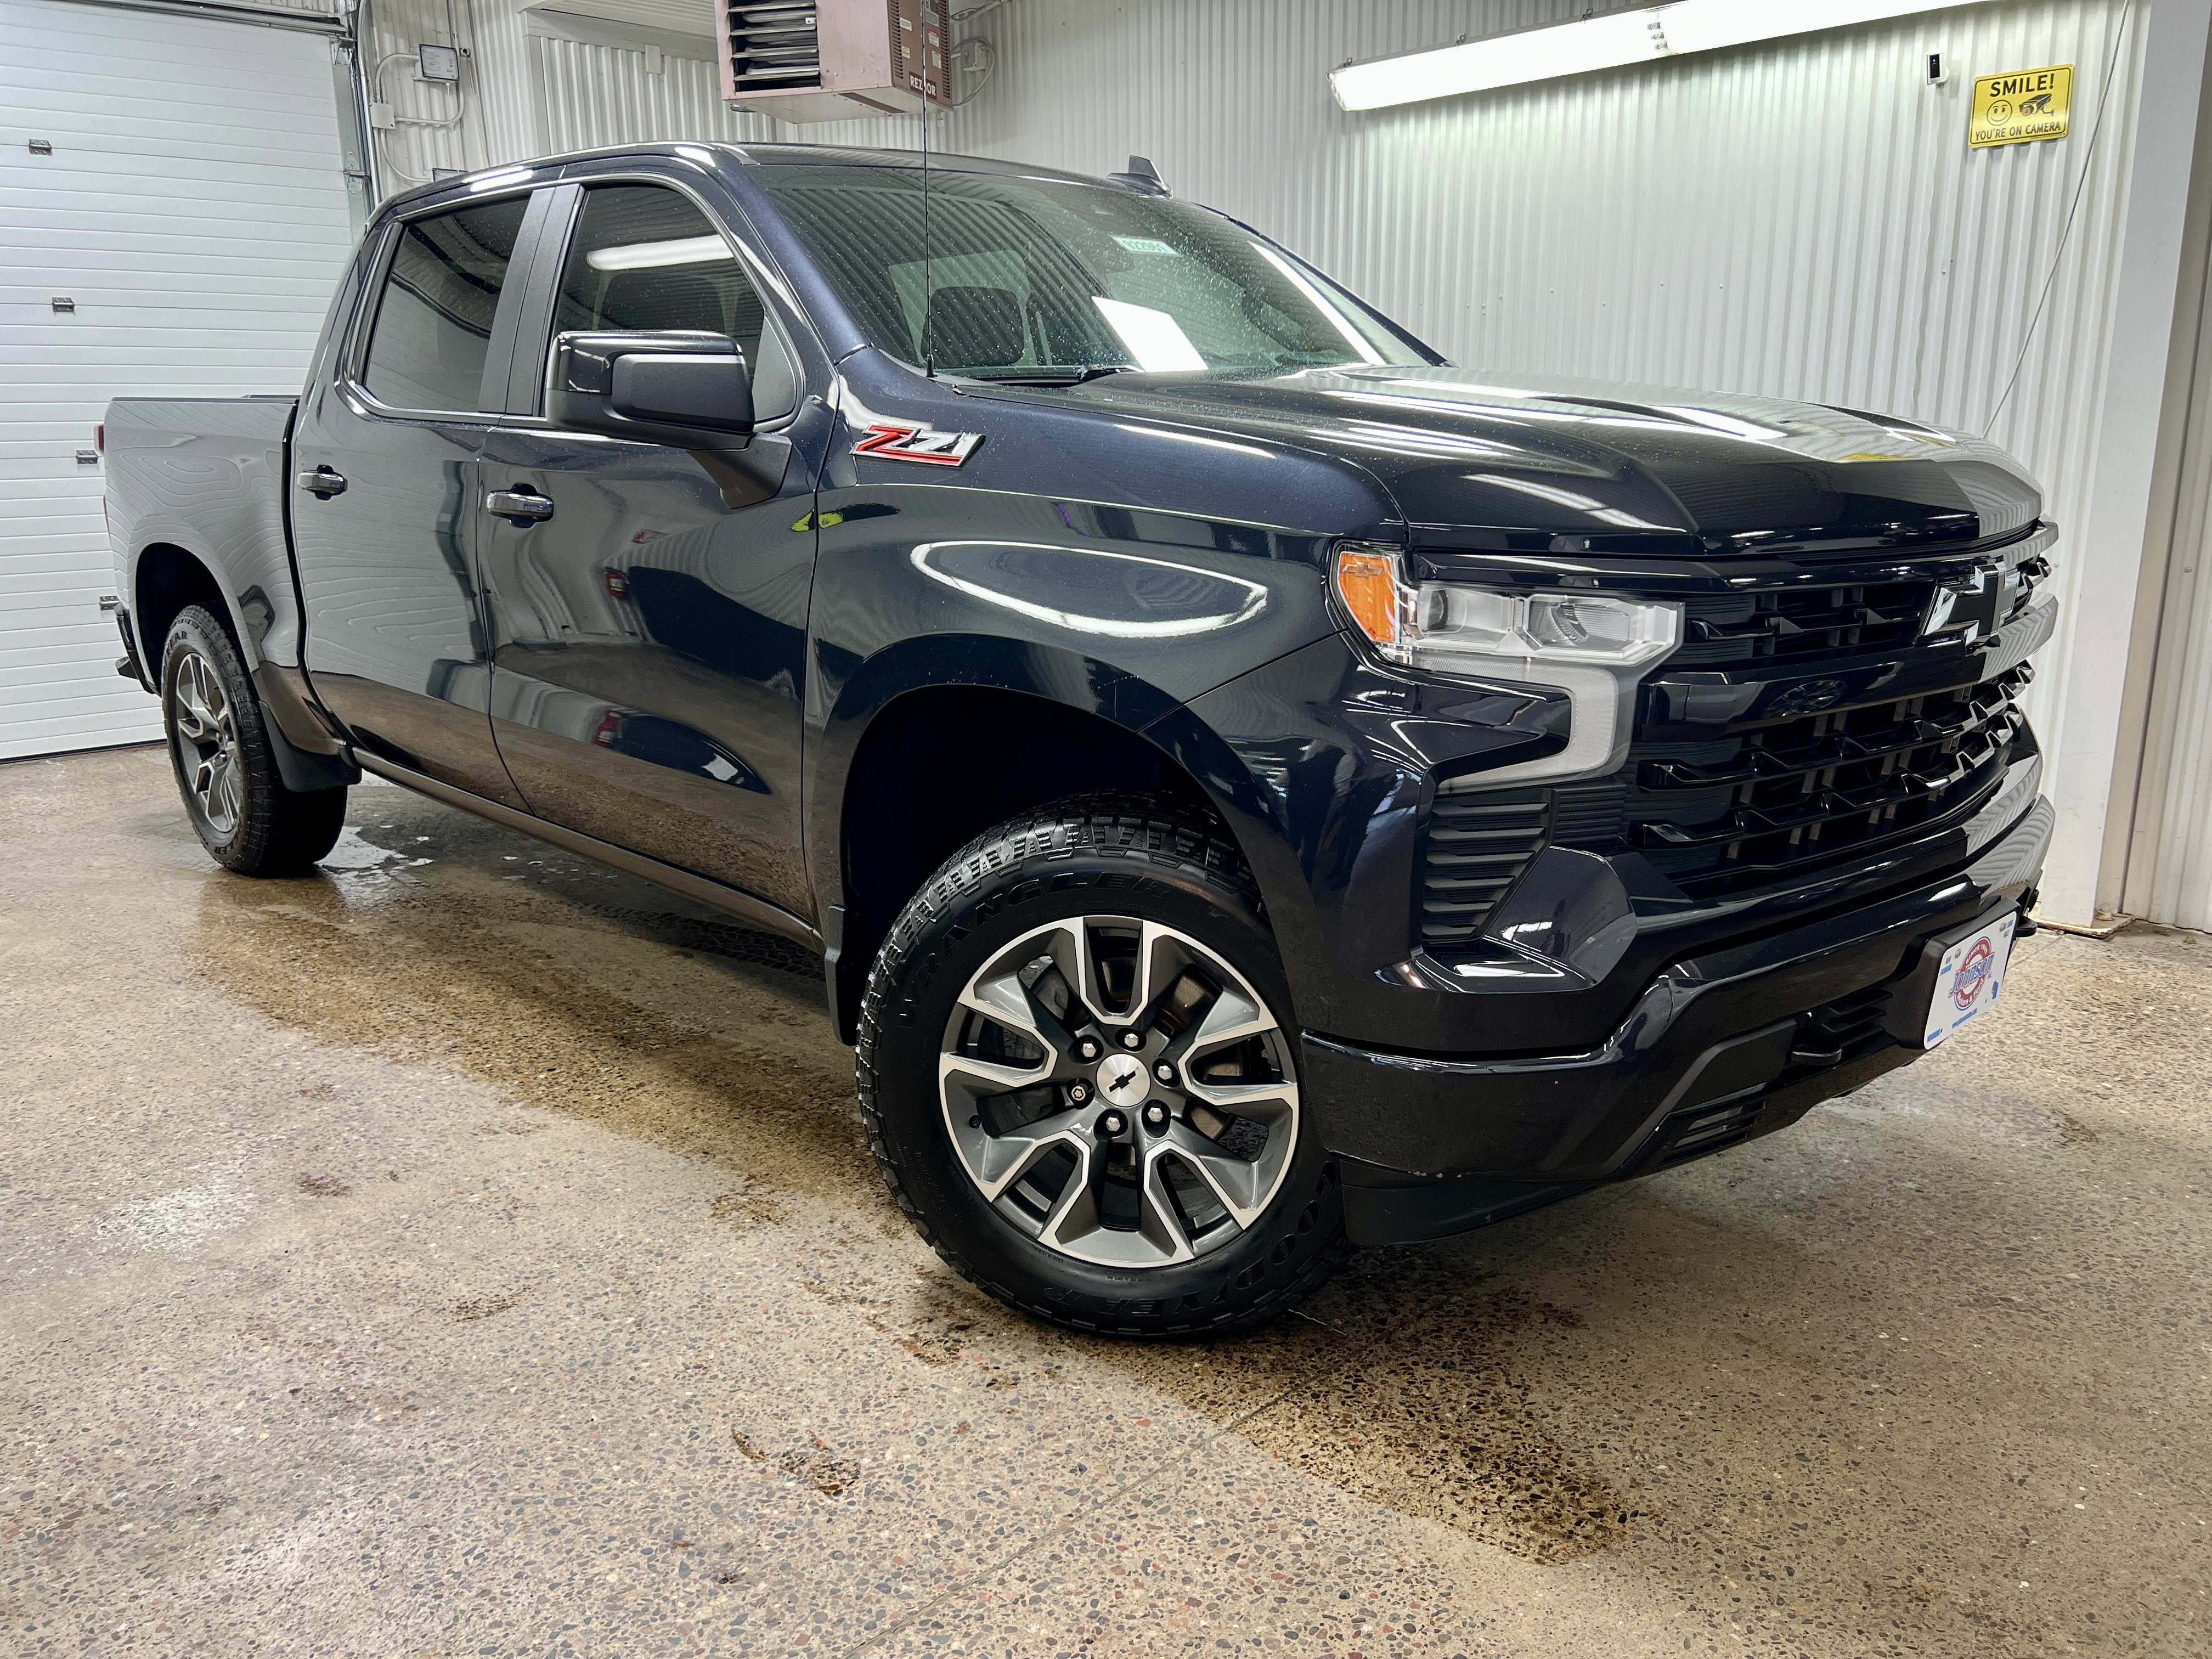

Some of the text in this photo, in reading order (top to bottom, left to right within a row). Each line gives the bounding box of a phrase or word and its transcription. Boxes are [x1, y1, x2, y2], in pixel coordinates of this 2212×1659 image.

[910, 75, 936, 97] REZOR
[1989, 73, 2055, 98] SMILE!
[1976, 127, 2006, 141] YOU'RE
[2010, 126, 2022, 137] ON
[2025, 121, 2061, 134] CAMERA
[849, 421, 986, 467] Z71
[898, 871, 1173, 1028] WRANGLER
[1949, 952, 1995, 997] Johnson
[1044, 1161, 1338, 1317] GOODYEAR
